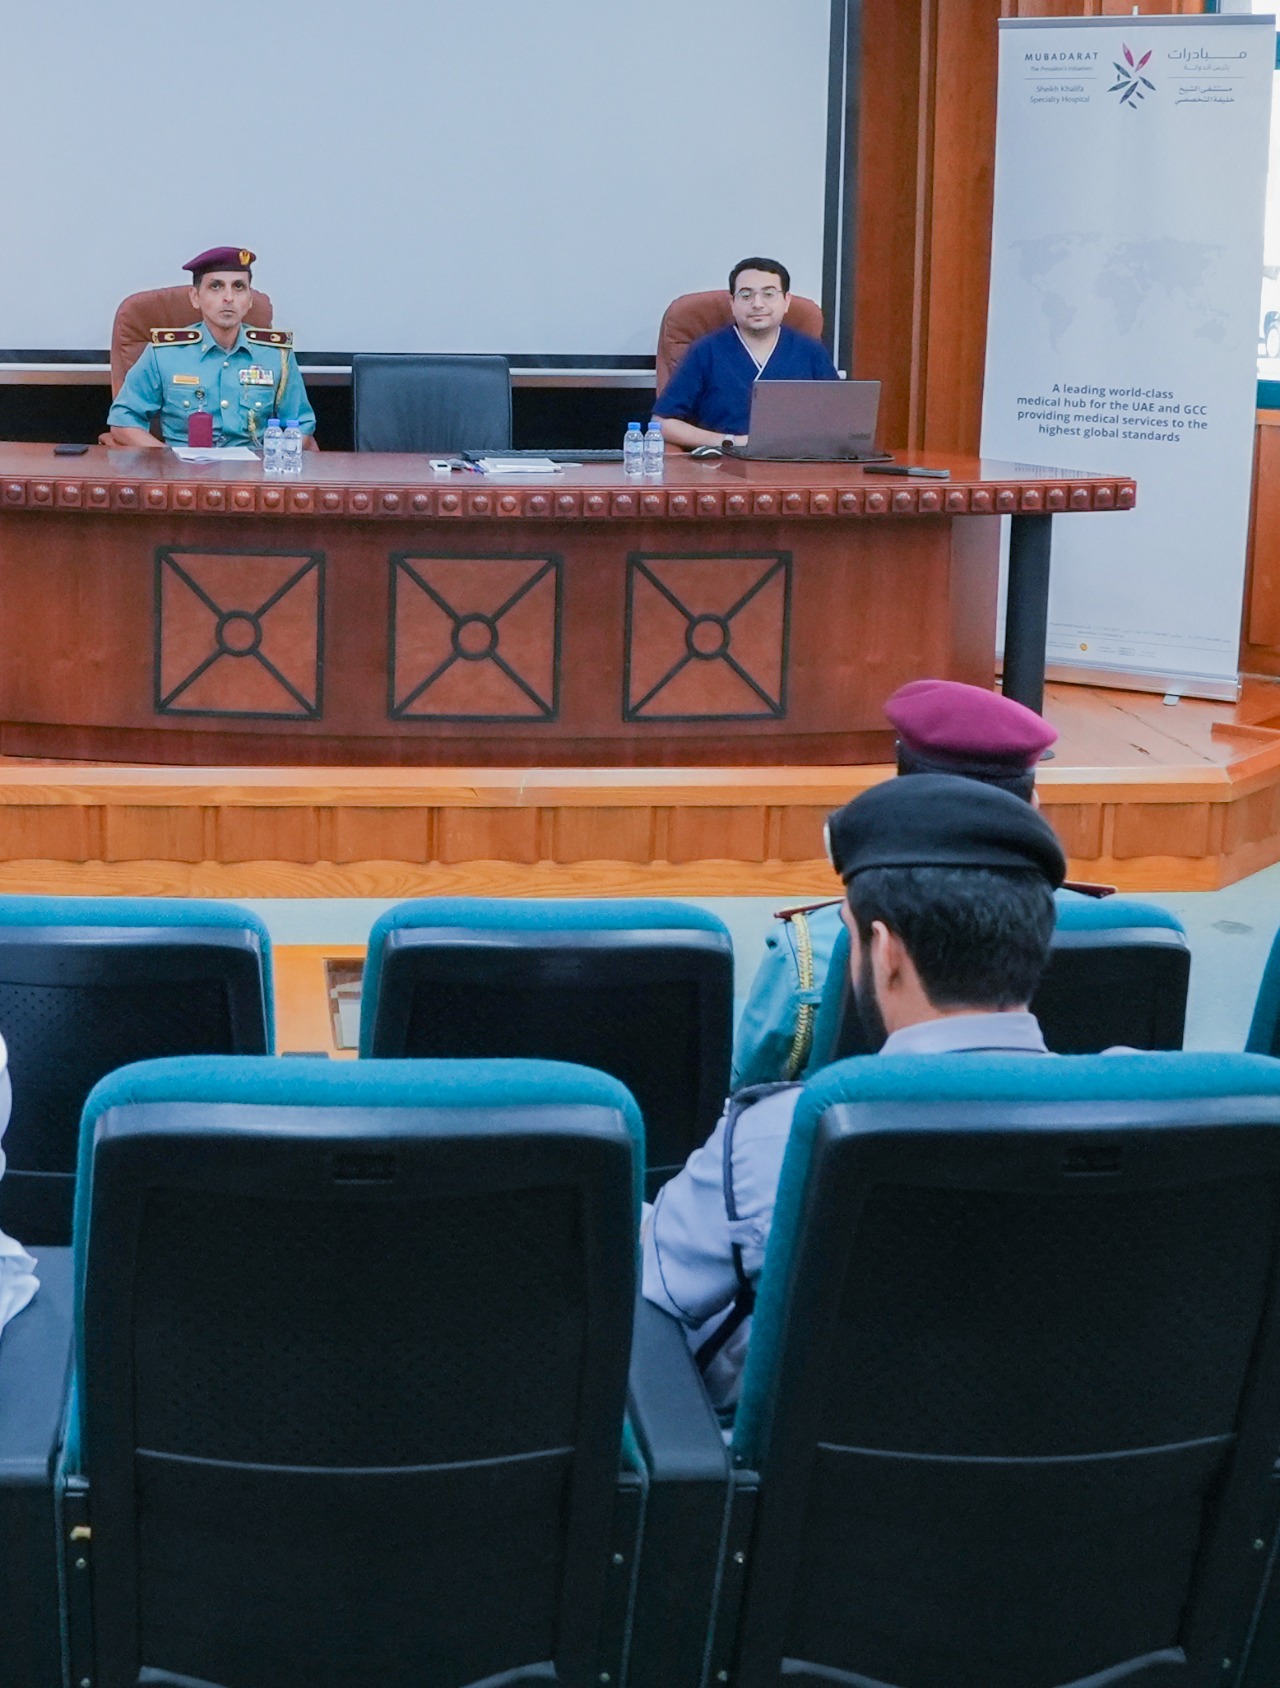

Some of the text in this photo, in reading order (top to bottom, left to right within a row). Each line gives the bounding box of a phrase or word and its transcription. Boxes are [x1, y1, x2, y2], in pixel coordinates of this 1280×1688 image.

[1024, 52, 1098, 61] MUBADARAT
[1167, 47, 1247, 61] مبادرات
[1030, 95, 1090, 104] Specialty Hospital
[1052, 384, 1174, 399] A leading world-class
[1017, 396, 1207, 415] medical hub for the UAE and GCC
[1017, 410, 1208, 429] providing medical services to the
[1039, 424, 1180, 442] highest global standards
